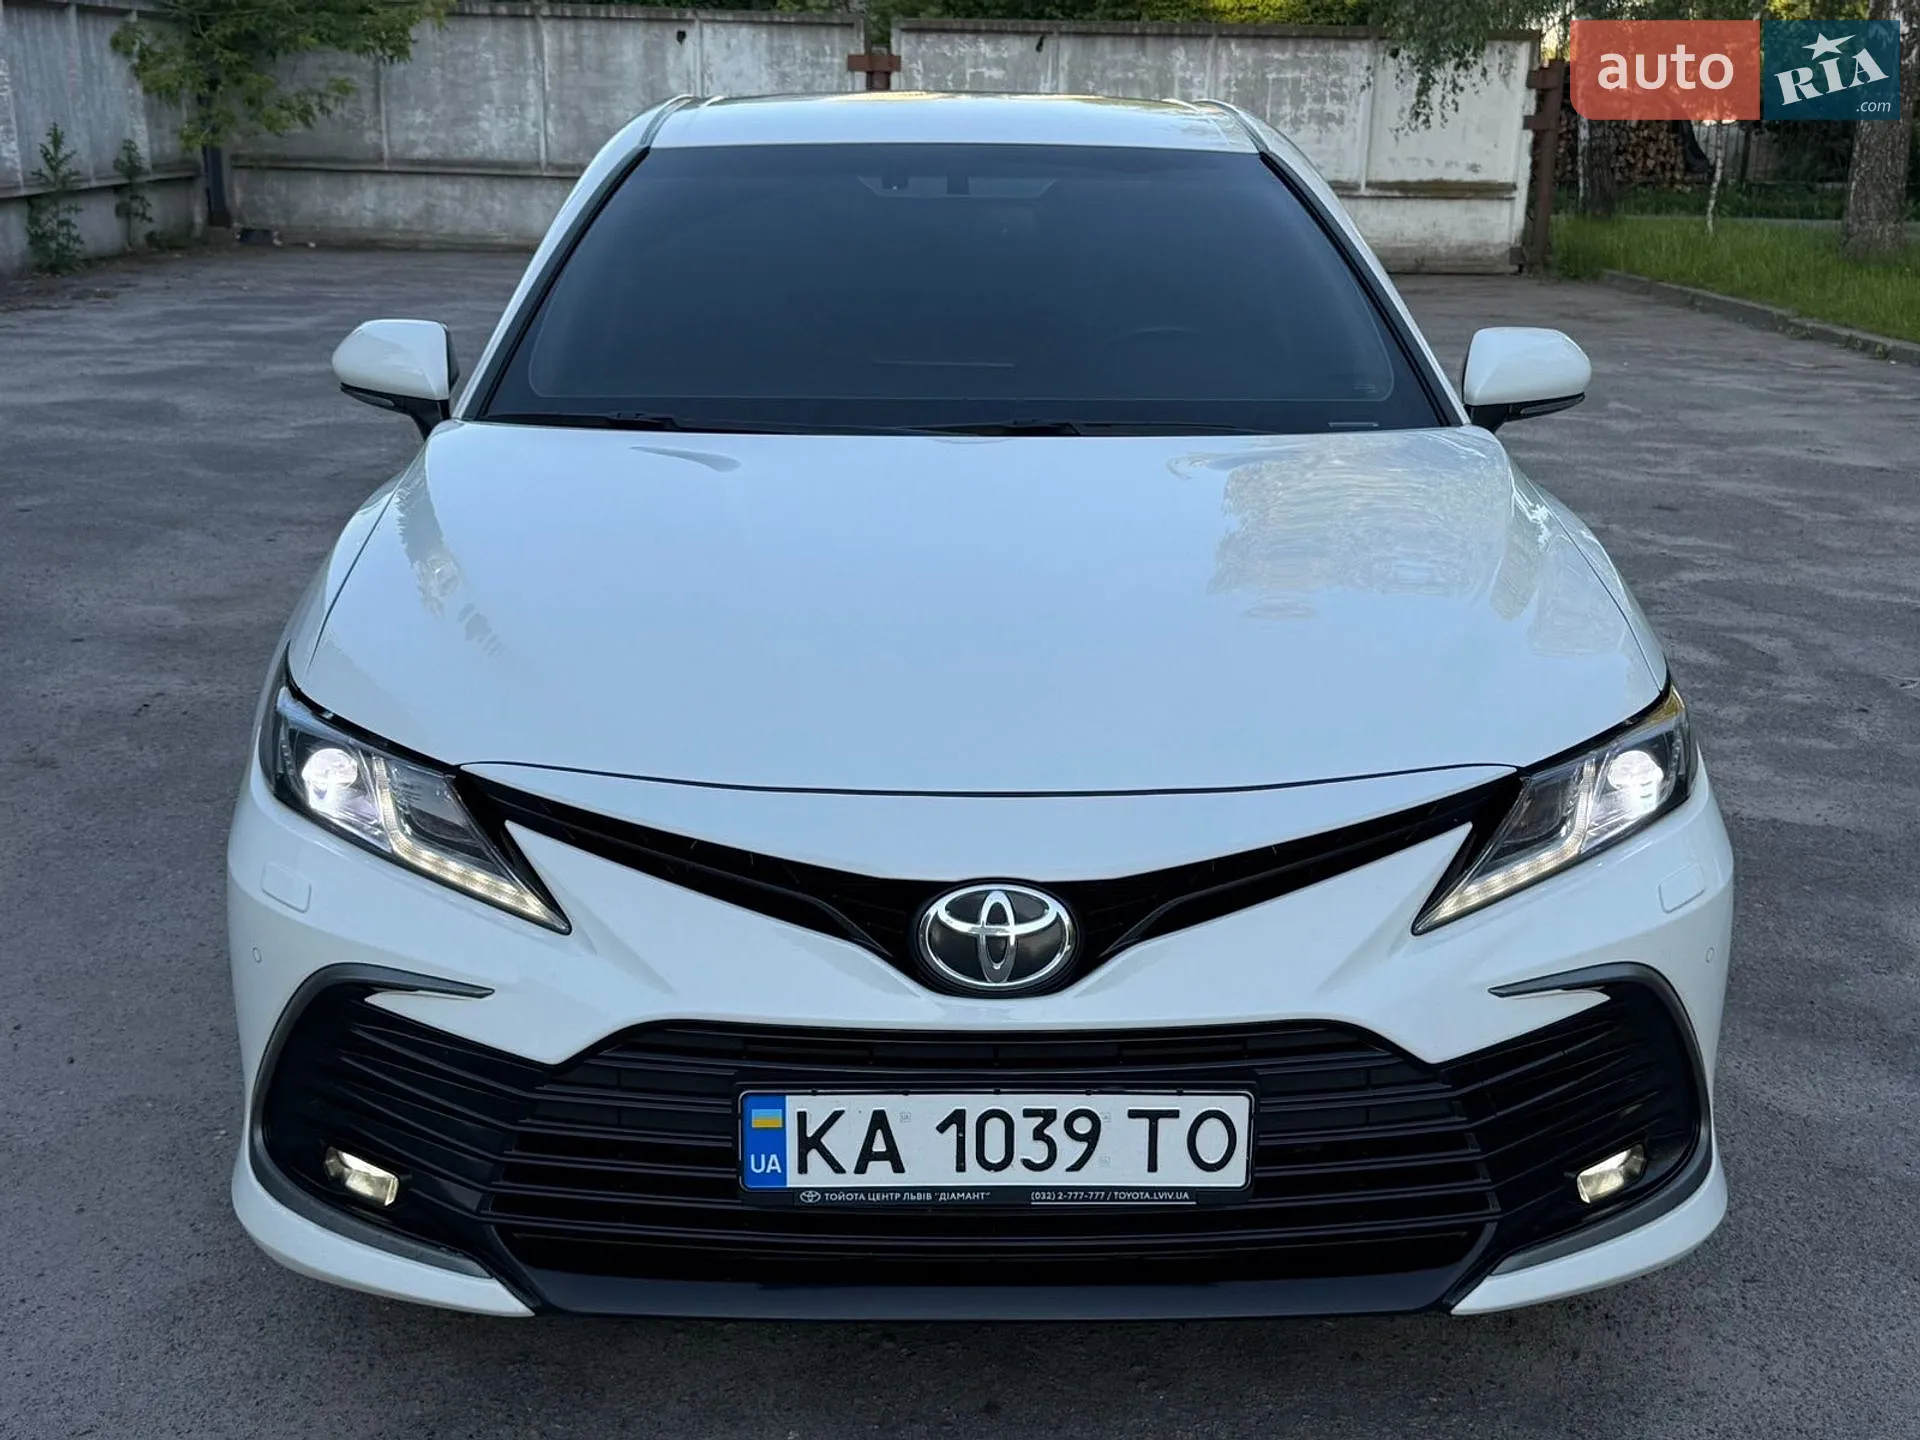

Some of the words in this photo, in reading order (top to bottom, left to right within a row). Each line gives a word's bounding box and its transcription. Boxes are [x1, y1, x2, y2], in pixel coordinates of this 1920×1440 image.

[797, 1110, 905, 1174] KA
[936, 1109, 1101, 1172] 1039
[1128, 1109, 1237, 1172] TO
[750, 1153, 782, 1173] UA
[824, 1192, 865, 1201] ТОЙОТА
[867, 1192, 900, 1202] ЦЕНТР
[903, 1192, 932, 1201] ЛЬВІВ
[1031, 1192, 1055, 1200] (032)
[1057, 1191, 1105, 1200] 2-777-777
[1114, 1191, 1189, 1200] TOYOTA.LVIV.UA
